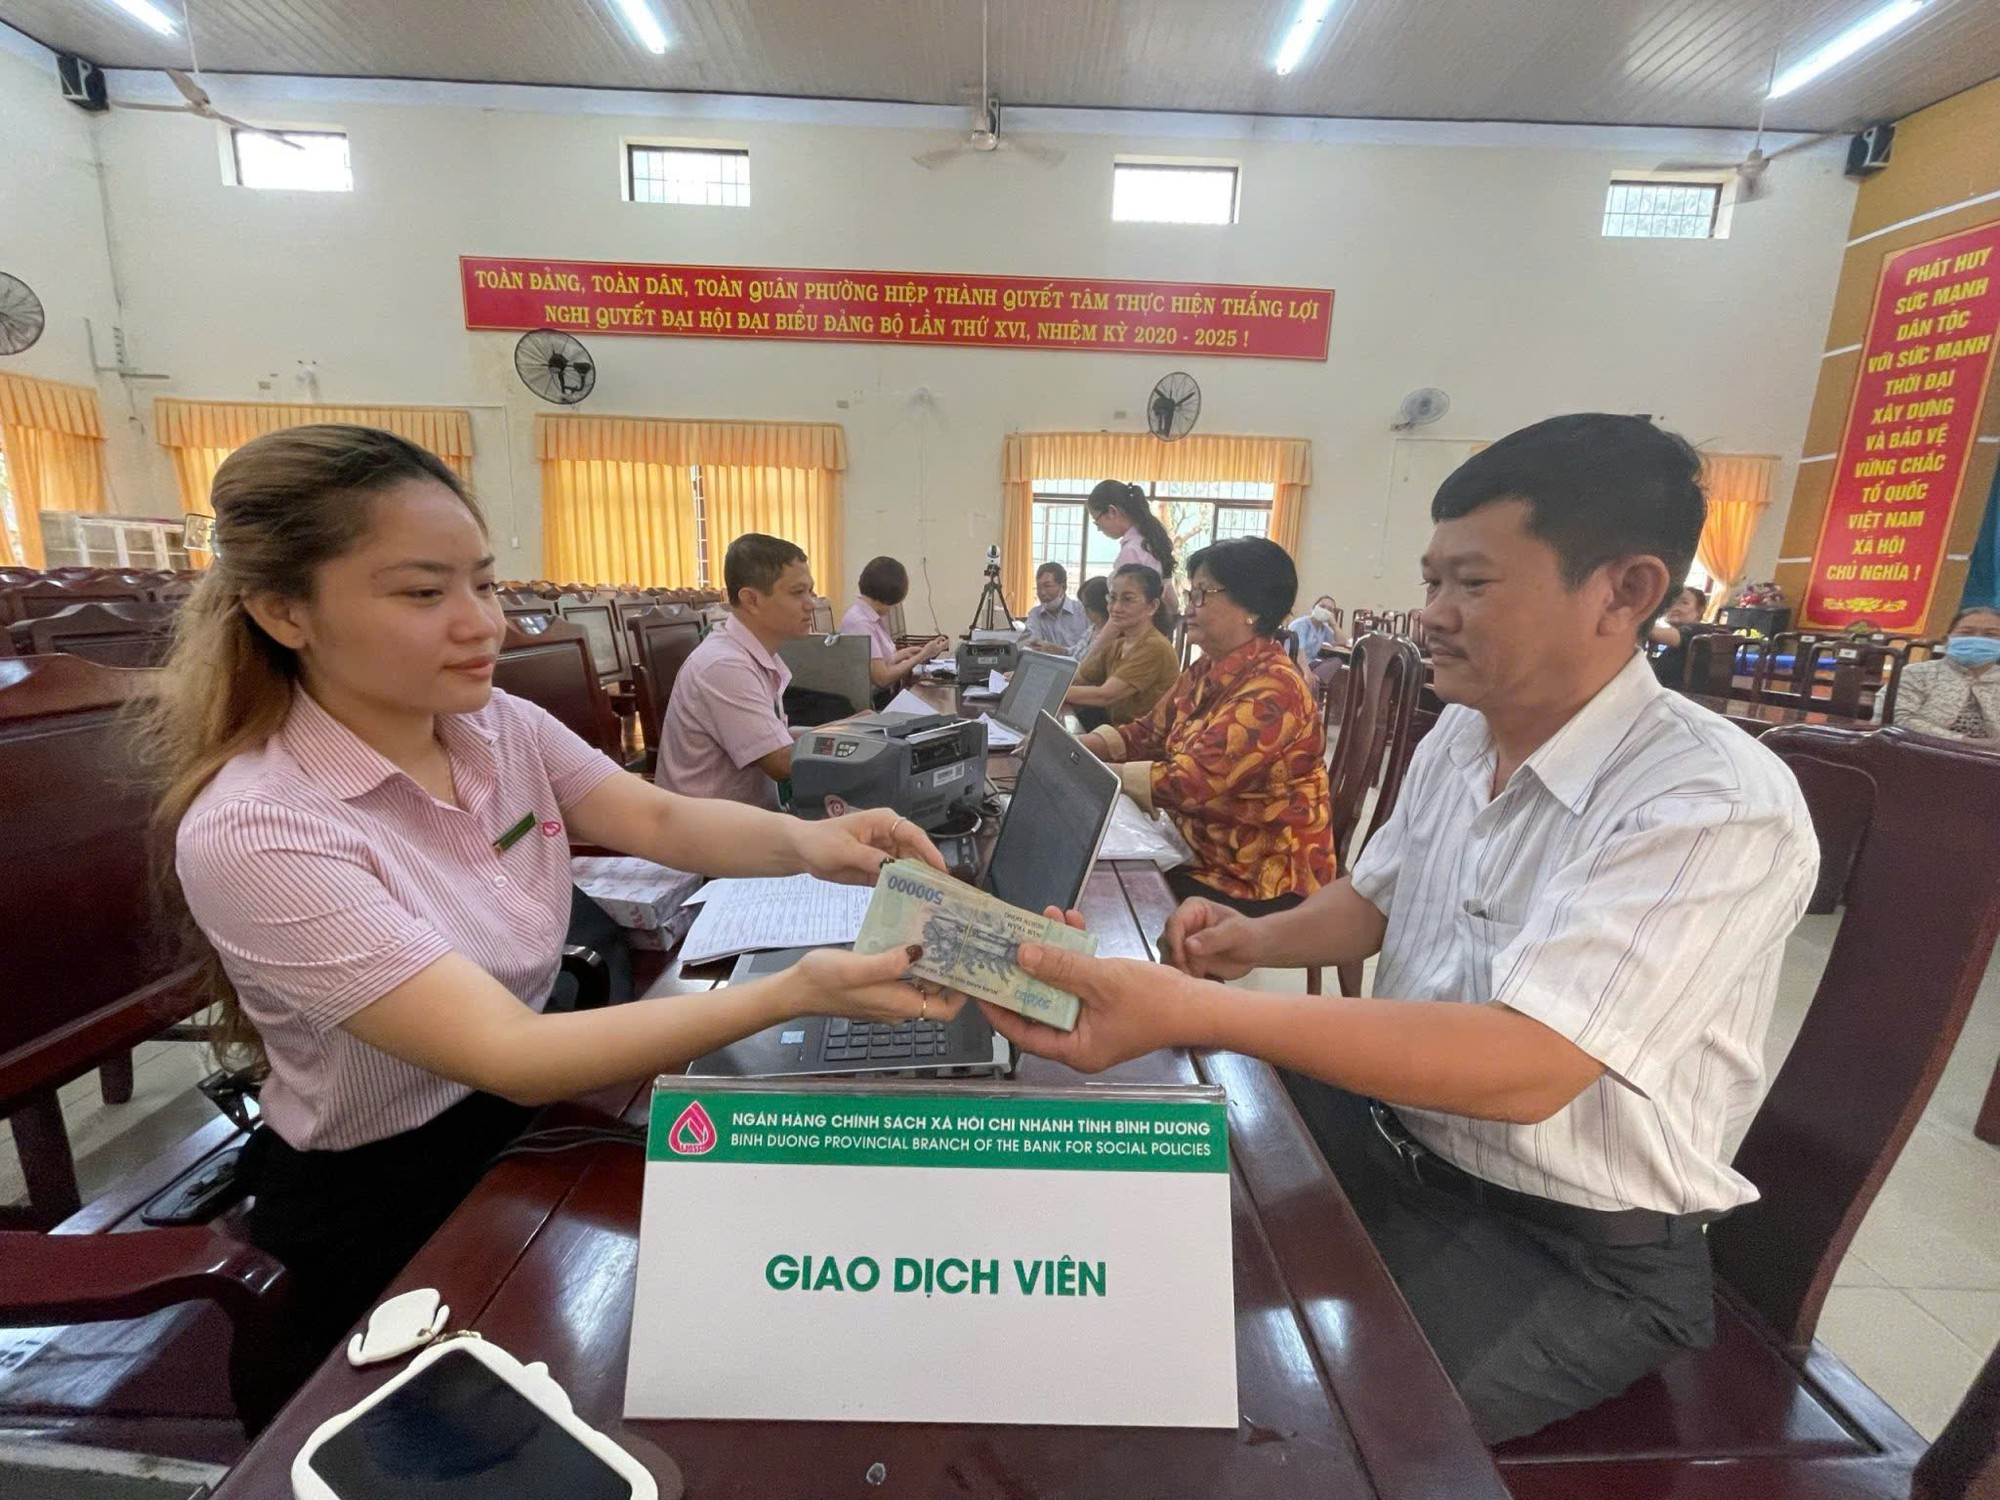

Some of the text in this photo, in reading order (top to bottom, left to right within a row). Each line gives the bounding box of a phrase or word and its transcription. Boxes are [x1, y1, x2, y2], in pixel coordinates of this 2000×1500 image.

[1905, 247, 1993, 285] PHÁT HUY
[475, 266, 1319, 323] TOÀN ĐẢNG, TOÀN DÂN, TOÀN QUÂN PHƯỜNG HIỆP THÀNH QUYẾT TÂM THỰC HIỆN THẮNG LỢI
[1932, 277, 1989, 306] MẠNH
[544, 305, 591, 328] NGHỊ
[595, 300, 656, 329] QUYẾT
[661, 309, 694, 331] ĐẠI
[700, 307, 733, 332] HỘI
[738, 312, 770, 334] ĐẠI
[775, 304, 818, 332] BIỂU
[824, 309, 875, 333] ĐẢNG
[880, 312, 904, 338] BỘ
[910, 308, 945, 335] LẦN
[951, 315, 989, 337] THỨ
[994, 321, 1030, 341] XVI,
[1037, 319, 1098, 344] NHIỆM
[1103, 321, 1129, 343] KỲ
[1134, 326, 1178, 344] 2020
[1194, 328, 1237, 347] 2025
[1896, 310, 1972, 341] DÂN TỘC
[1934, 335, 1992, 362] MẠNH
[1870, 404, 1904, 425] XÂY
[1866, 423, 1949, 451] VÀ BẢO VỆ
[1884, 479, 1929, 502] QUỐC
[1848, 510, 1925, 532] VIỆT NAM
[1876, 535, 1906, 558] HỘI
[1826, 560, 1922, 581] CHỦ NGHĨA !
[888, 875, 945, 905] 500000
[732, 1110, 778, 1126] NGÂN
[782, 1111, 827, 1128] HÀNG
[831, 1112, 879, 1129] CHÍNH
[883, 1113, 926, 1130] SÁCH
[988, 1117, 1015, 1132] CHI
[1020, 1117, 1073, 1133] NHÁNH
[1115, 1118, 1150, 1134] BÌNH
[731, 1133, 1211, 1156] BINH DUONG PROVINCIAL BRANCH OF THE BANK FOR SOCIAL POLICIES
[765, 1254, 1107, 1298] GIAO DỊCH VIÊN
